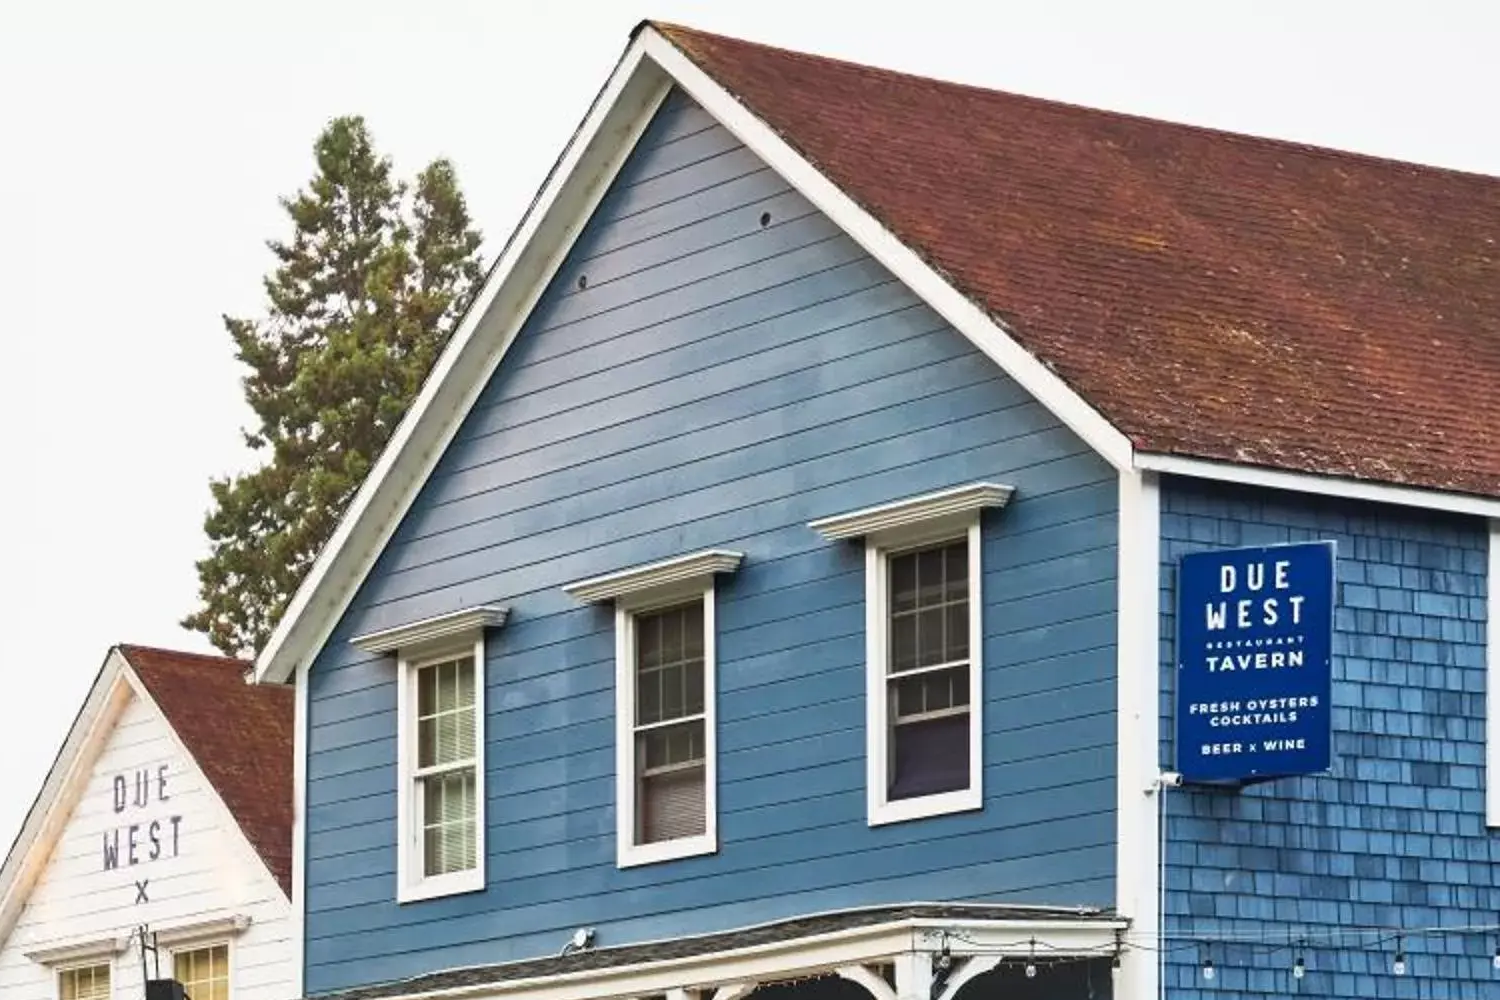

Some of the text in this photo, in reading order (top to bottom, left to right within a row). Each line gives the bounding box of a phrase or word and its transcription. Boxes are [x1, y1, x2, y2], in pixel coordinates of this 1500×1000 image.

[1220, 560, 1291, 593] DUE
[1206, 596, 1305, 631] WEST
[1206, 651, 1303, 672] TAVERN
[1190, 696, 1319, 714] FRESH OYSTERS
[1210, 711, 1297, 727] COCKTAILS
[1201, 743, 1242, 755] BEER
[1264, 739, 1305, 751] WINE
[114, 764, 170, 814] DUE
[103, 815, 182, 871] WEST
[135, 879, 149, 905] X
